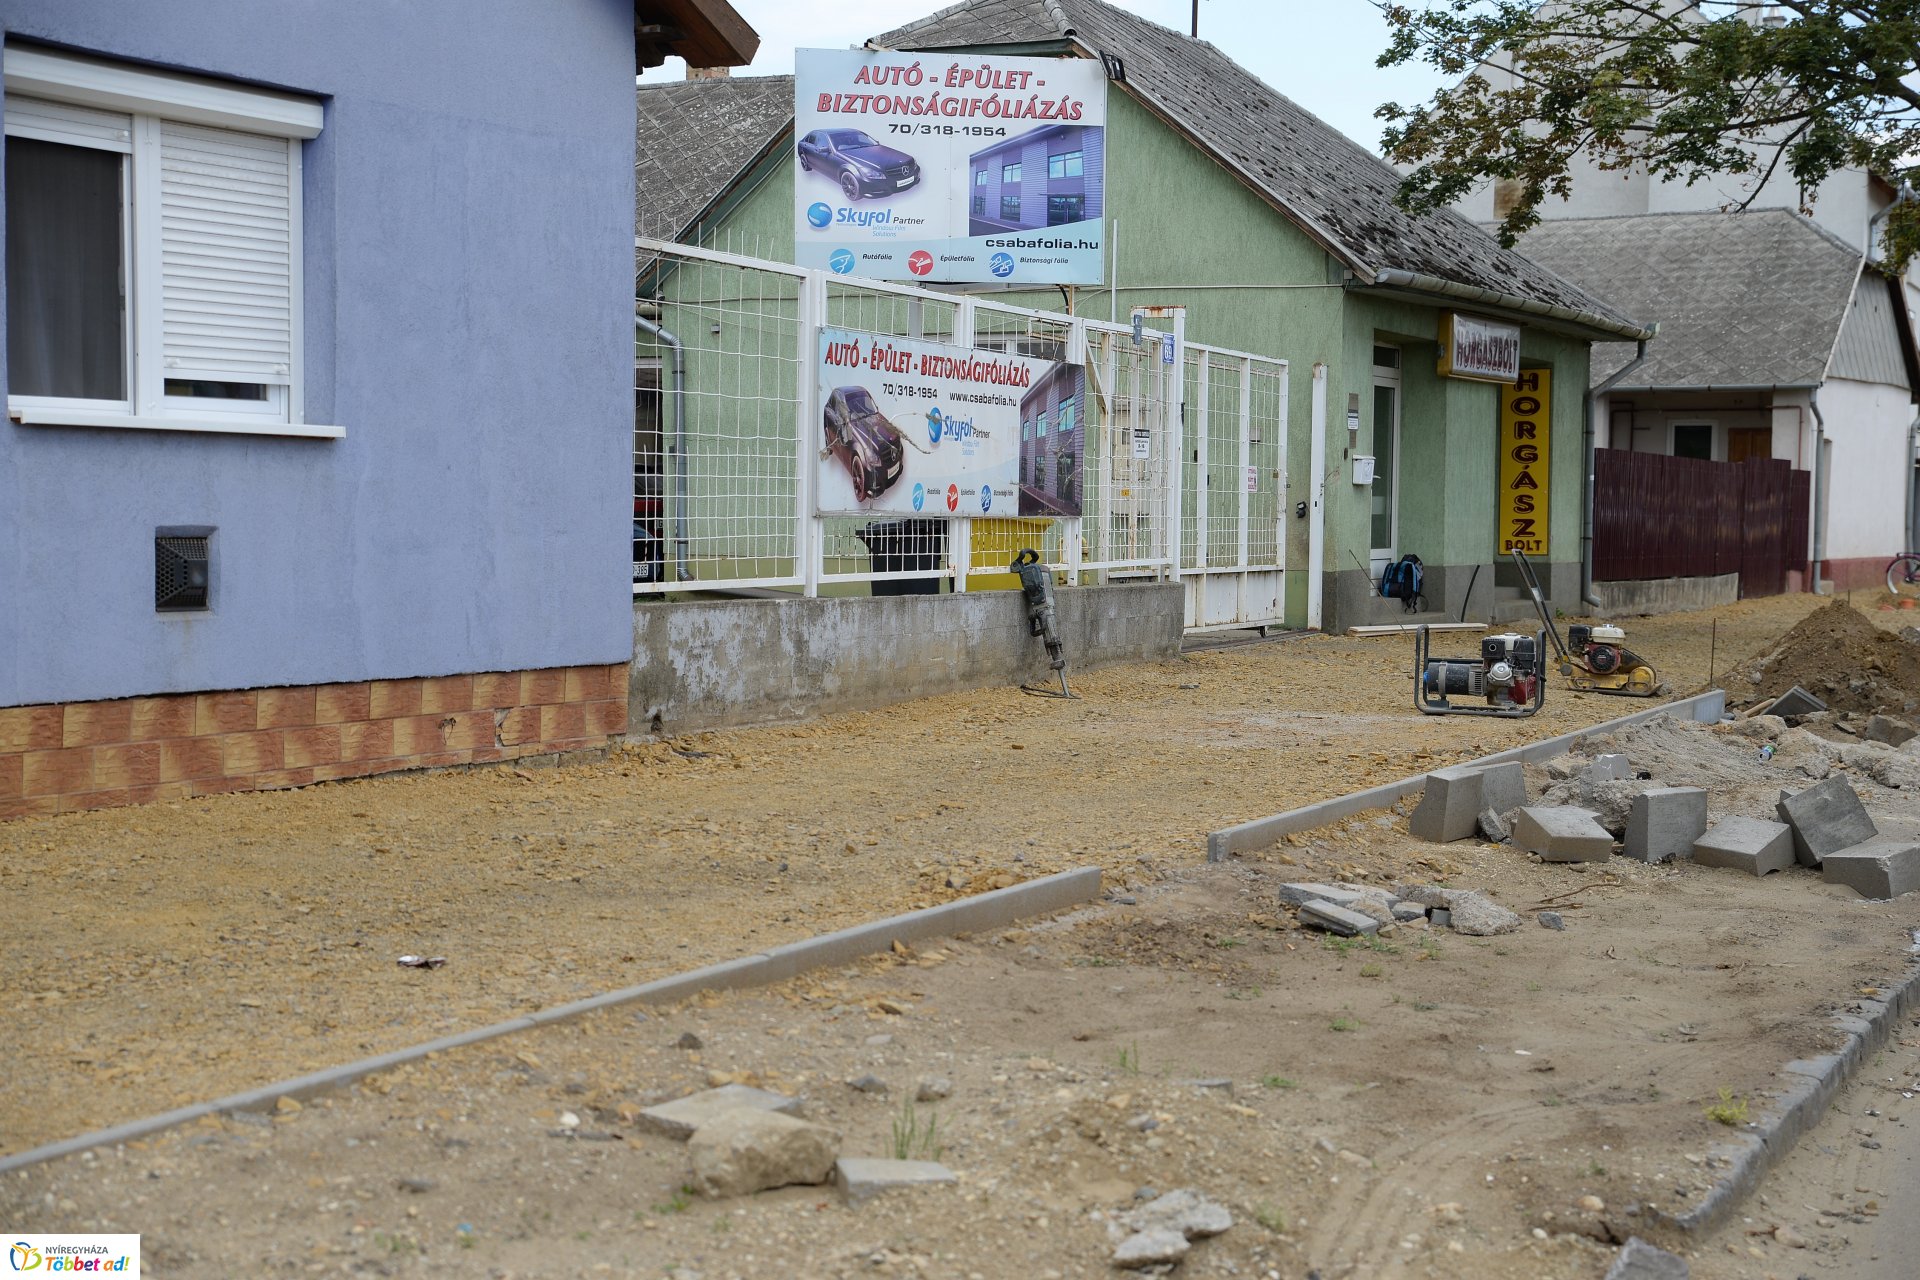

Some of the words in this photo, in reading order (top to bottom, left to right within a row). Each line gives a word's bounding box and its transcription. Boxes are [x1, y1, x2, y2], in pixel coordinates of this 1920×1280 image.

[854, 61, 923, 86] AUTÓ
[945, 62, 1032, 90] ÉPÜLET
[816, 91, 1083, 121] BIZTONSÁGIFÓLIÁZÁS
[888, 123, 1007, 137] 70/318-1954
[836, 207, 892, 226] Skyfol
[893, 216, 925, 225] Partner
[985, 237, 1099, 250] csabafolia.hu
[825, 338, 860, 368] AUTÓ
[870, 341, 912, 374] ÉPÜLET
[920, 354, 1030, 388] BIZTONSÁGIFÓLIÁZÁS
[882, 382, 938, 399] 70/318-1954
[949, 390, 1017, 407] www.csabafolia.hu
[943, 415, 973, 441] Skyfol
[1505, 539, 1542, 550] BOLT
